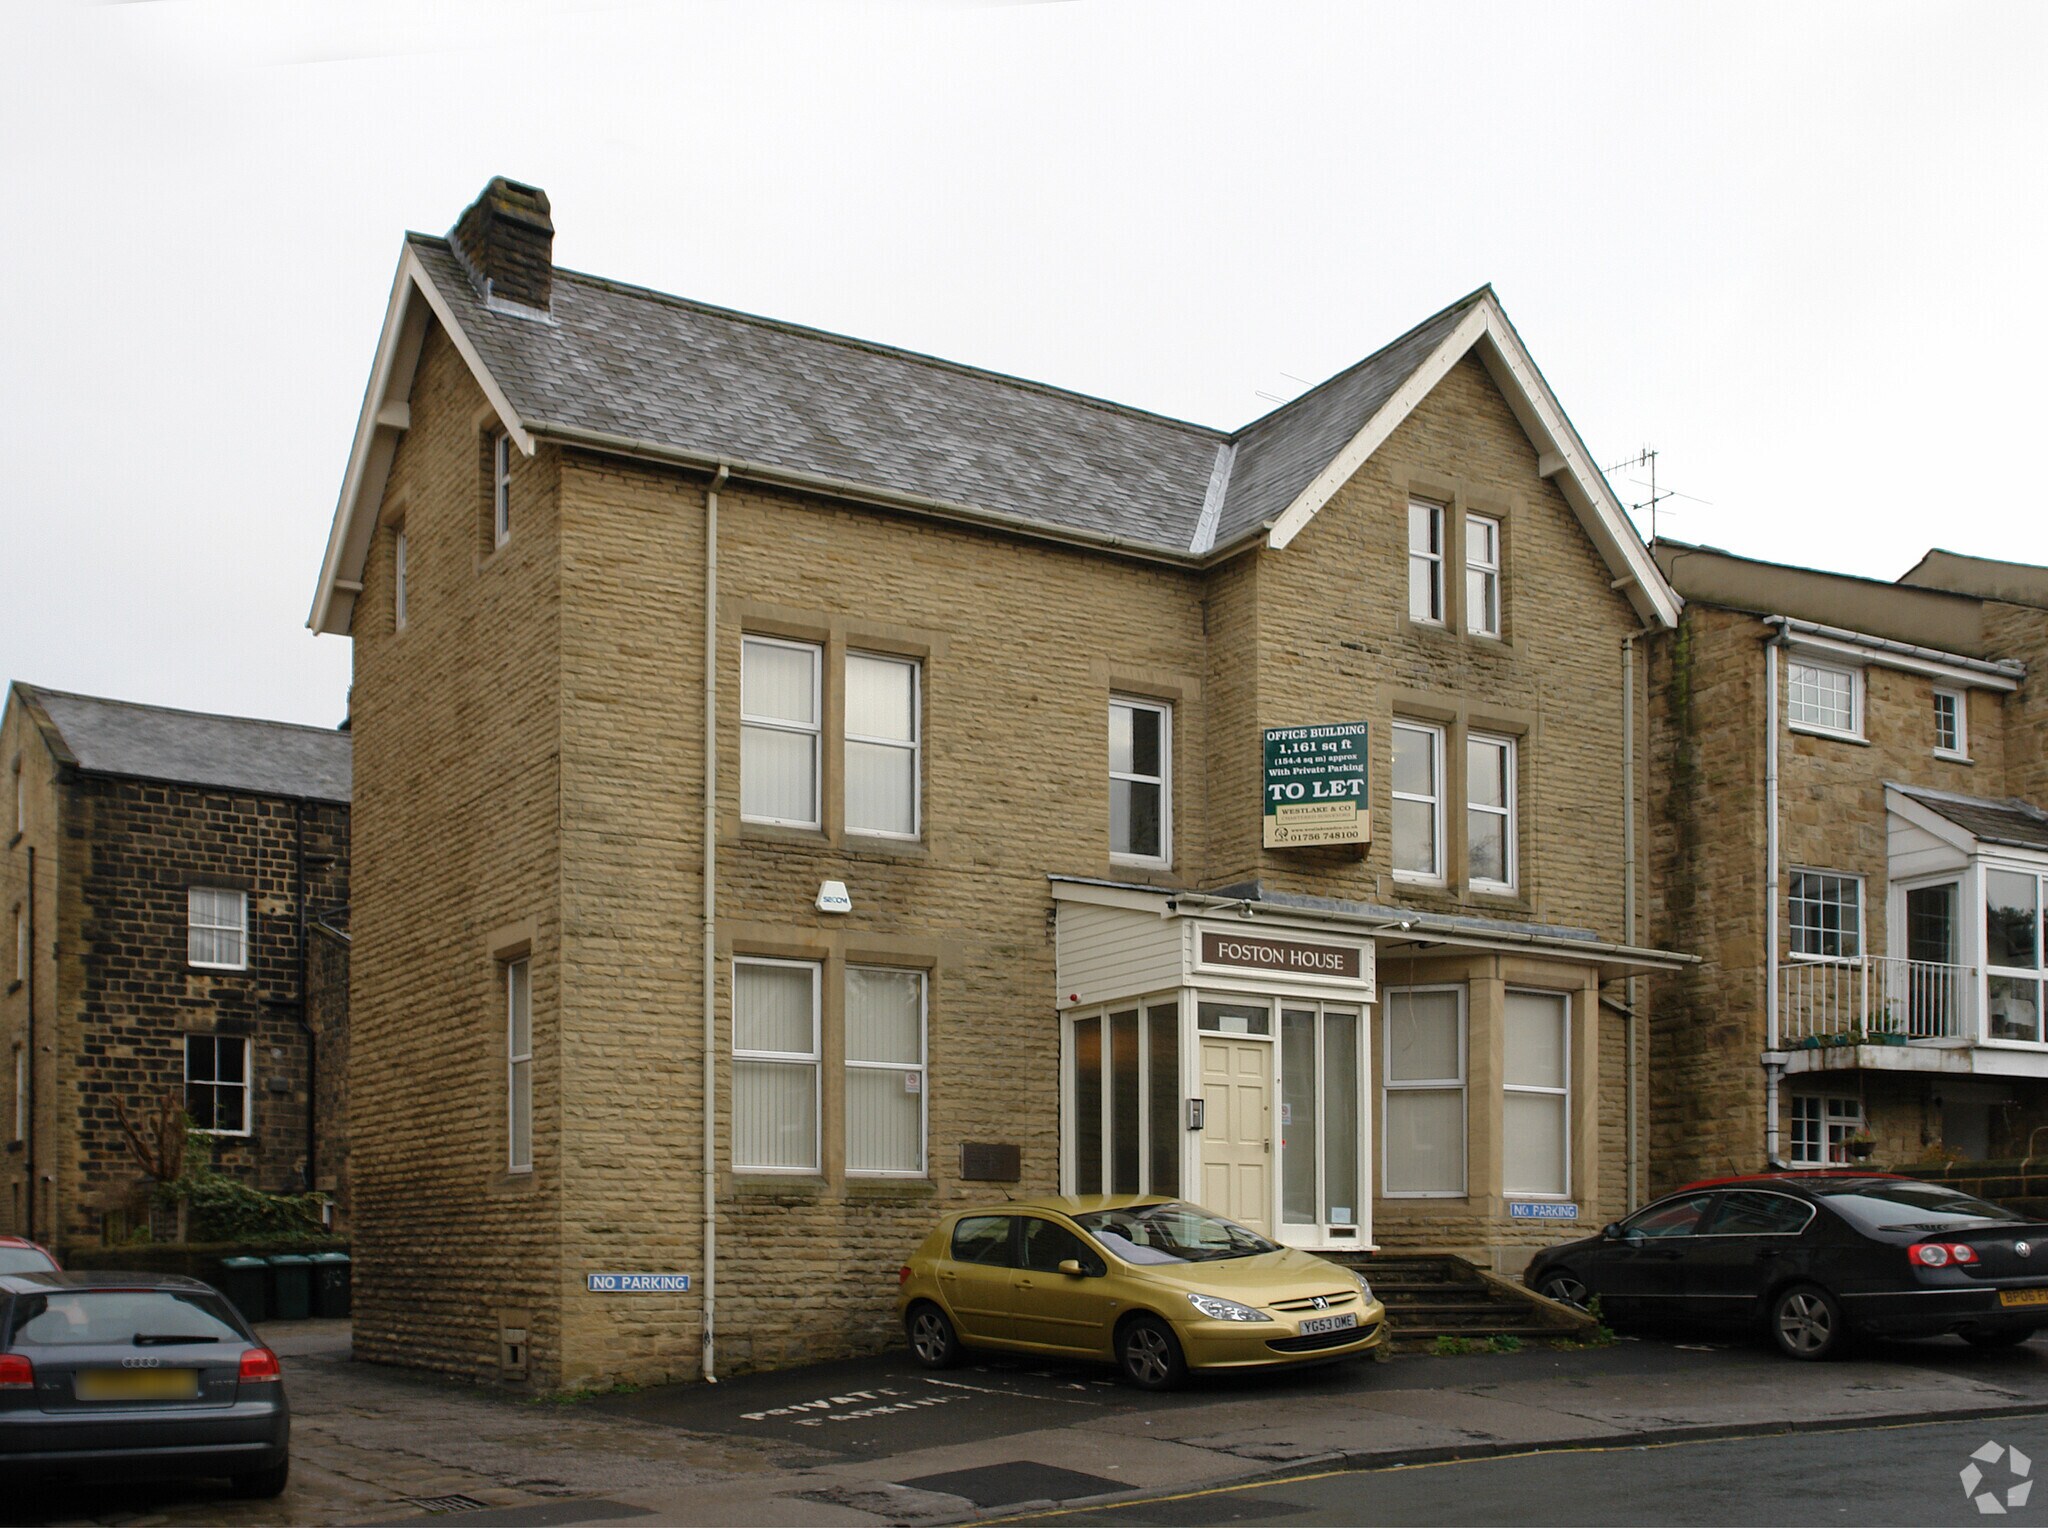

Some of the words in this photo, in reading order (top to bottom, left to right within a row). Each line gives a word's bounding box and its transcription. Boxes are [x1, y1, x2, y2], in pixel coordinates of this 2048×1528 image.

[1267, 729, 1307, 741] OFFICE
[1310, 725, 1365, 738] BUILDING
[1279, 742, 1317, 754] 1,161
[1322, 742, 1337, 752] sq
[1341, 739, 1352, 749] ft
[1328, 754, 1358, 762] approx
[1268, 768, 1291, 777] With
[1293, 766, 1326, 775] Private
[1327, 764, 1364, 772] Parking
[1268, 783, 1305, 800] TO
[1312, 779, 1364, 798] LET
[1281, 806, 1328, 815] WESTLAKE
[1290, 833, 1320, 842] 01756
[1323, 831, 1359, 840] 748100
[1218, 942, 1284, 964] FOSTON
[1290, 950, 1344, 970] HOUSE
[1513, 1204, 1529, 1216] NO
[1533, 1205, 1575, 1217] PARKING
[593, 1276, 616, 1289] NO
[621, 1277, 685, 1289] PARKING
[1304, 1319, 1333, 1333] YG53
